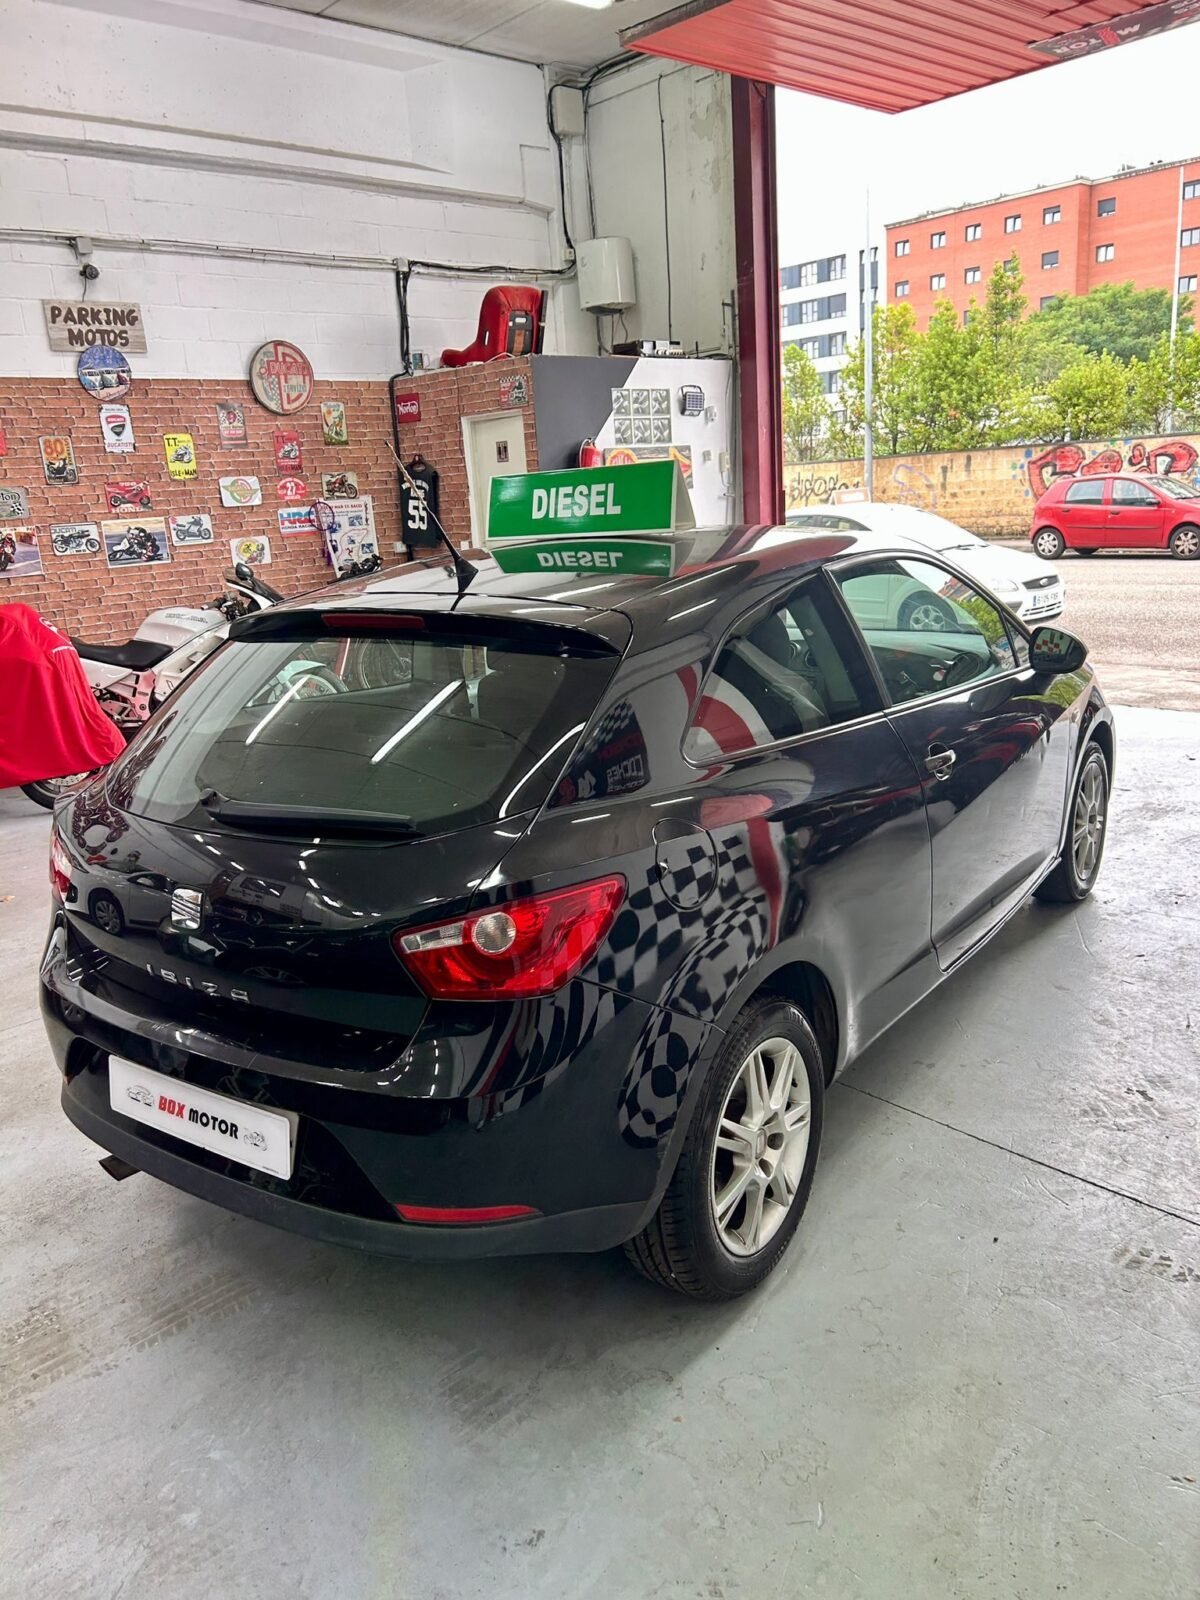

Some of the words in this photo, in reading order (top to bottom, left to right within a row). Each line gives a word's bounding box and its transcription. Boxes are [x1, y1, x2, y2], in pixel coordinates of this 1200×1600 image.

[50, 305, 139, 327] PARKING
[68, 328, 130, 346] MOTOS
[397, 401, 419, 416] Norton
[407, 499, 427, 530] 55
[531, 482, 621, 520] DIESEL
[146, 963, 250, 1002] IBIZA
[158, 1094, 186, 1119] BOX
[188, 1109, 239, 1140] MOTOR
